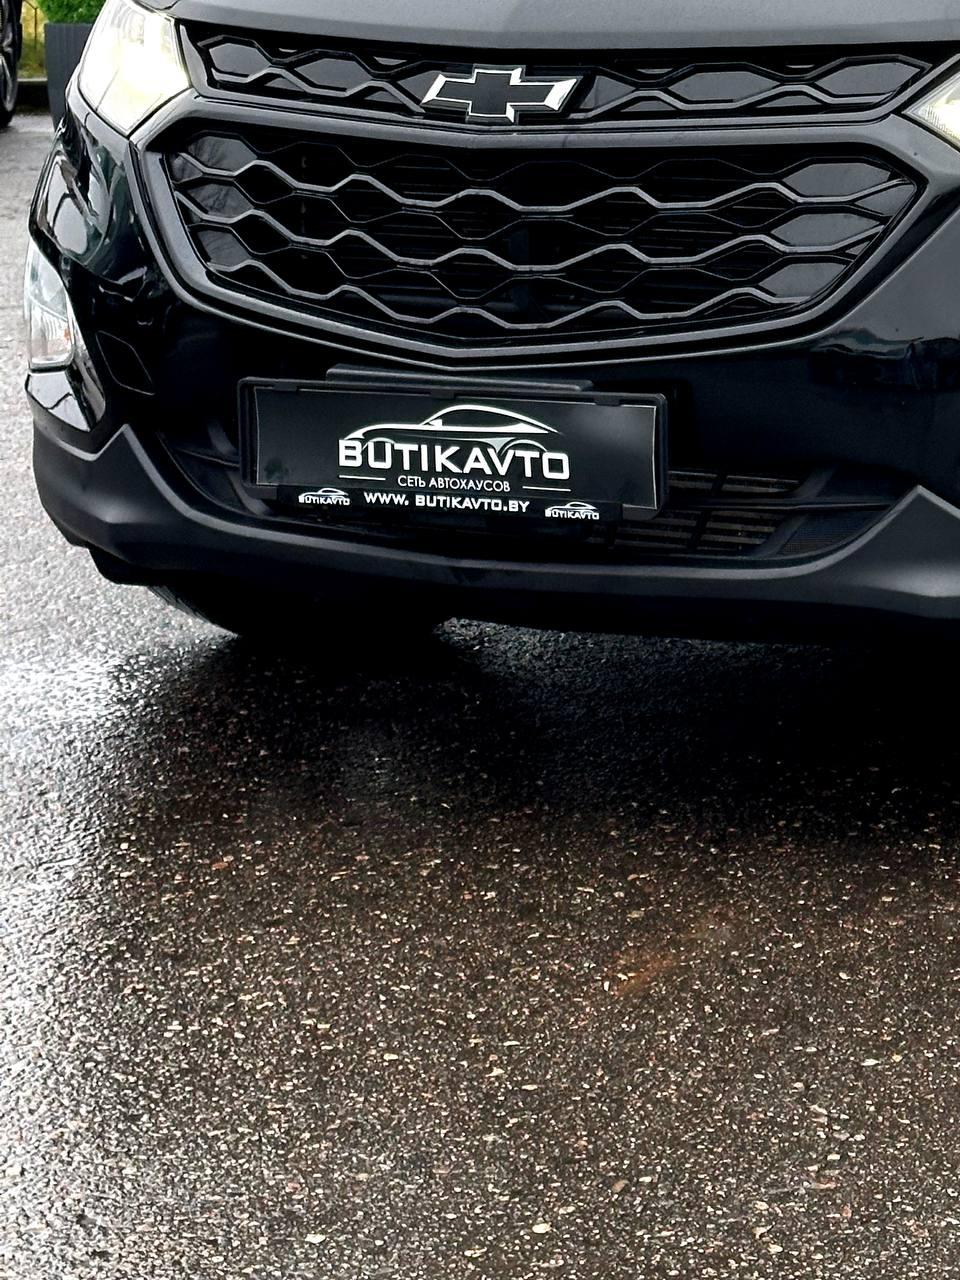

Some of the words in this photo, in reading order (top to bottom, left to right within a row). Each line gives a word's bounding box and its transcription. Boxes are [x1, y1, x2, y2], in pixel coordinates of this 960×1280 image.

[339, 439, 570, 480] BUTIKAVTO
[398, 475, 426, 489] СЕТЬ
[428, 477, 511, 493] АВТОХАУСОВ
[298, 495, 350, 505] BUTIKAVTO
[416, 495, 530, 513] BUTIKAVTO.BY
[544, 509, 600, 520] BUTIKAVTO
